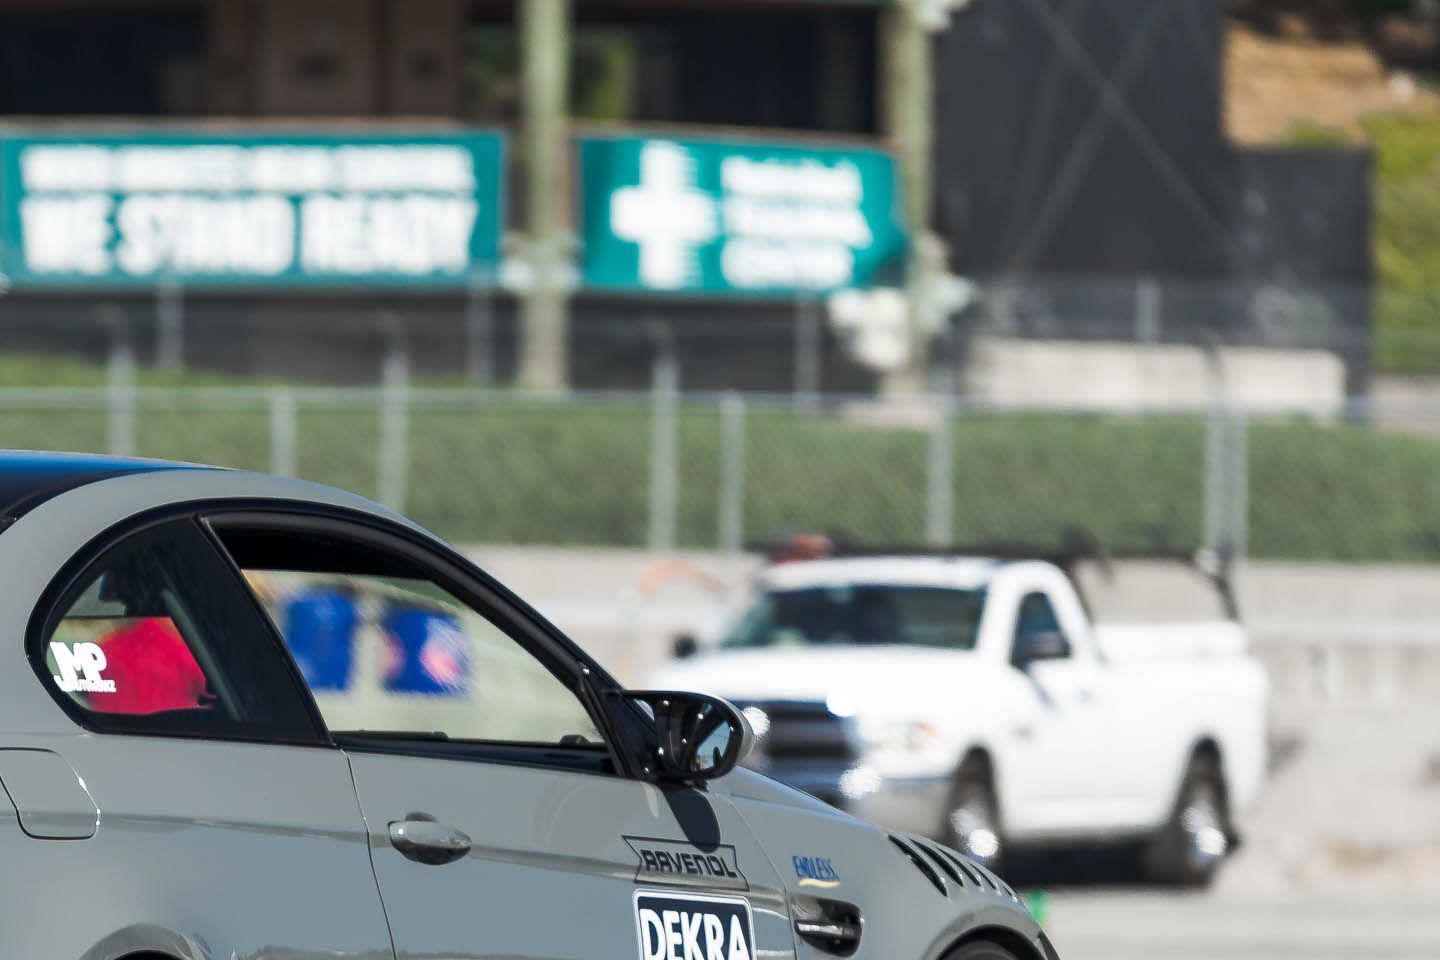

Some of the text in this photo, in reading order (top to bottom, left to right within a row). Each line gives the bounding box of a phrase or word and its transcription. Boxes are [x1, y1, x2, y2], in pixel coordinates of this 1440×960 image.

[22, 198, 112, 273] WE
[640, 849, 738, 878] RAVENOL
[791, 855, 840, 881] ENDLESS
